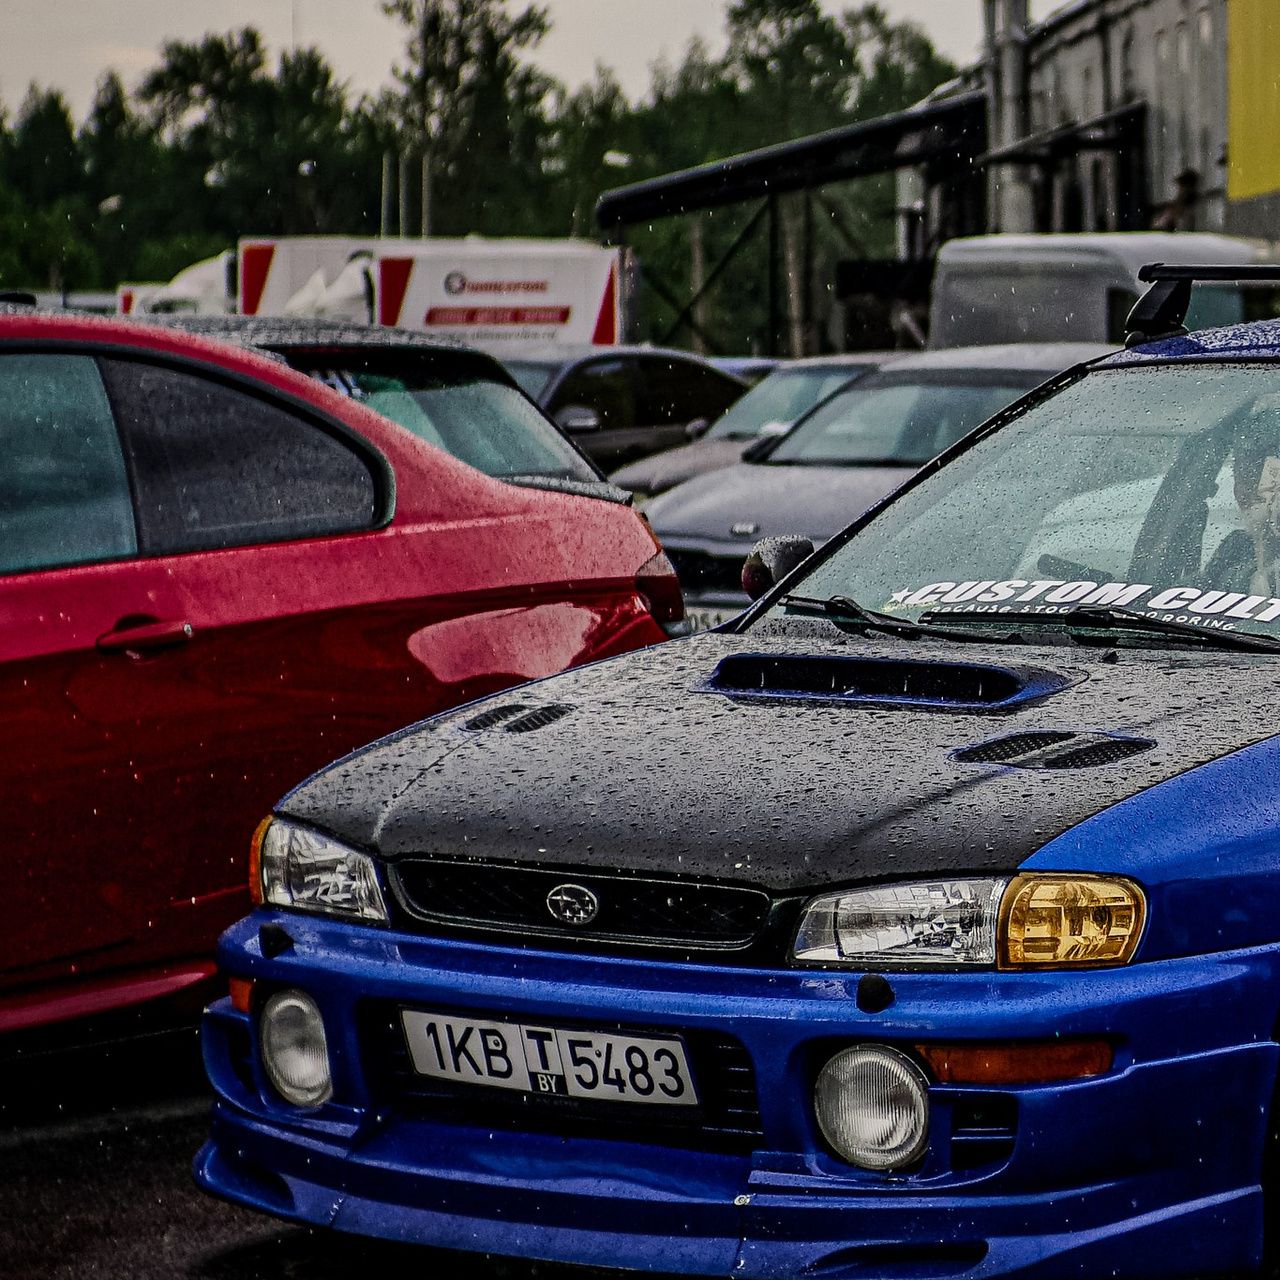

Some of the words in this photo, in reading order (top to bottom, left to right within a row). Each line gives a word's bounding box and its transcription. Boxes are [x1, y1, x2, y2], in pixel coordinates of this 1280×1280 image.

[904, 580, 1152, 606] CUSTOM
[426, 1022, 513, 1079] 1KB
[567, 1039, 685, 1098] 5483
[537, 1074, 557, 1093] BY
